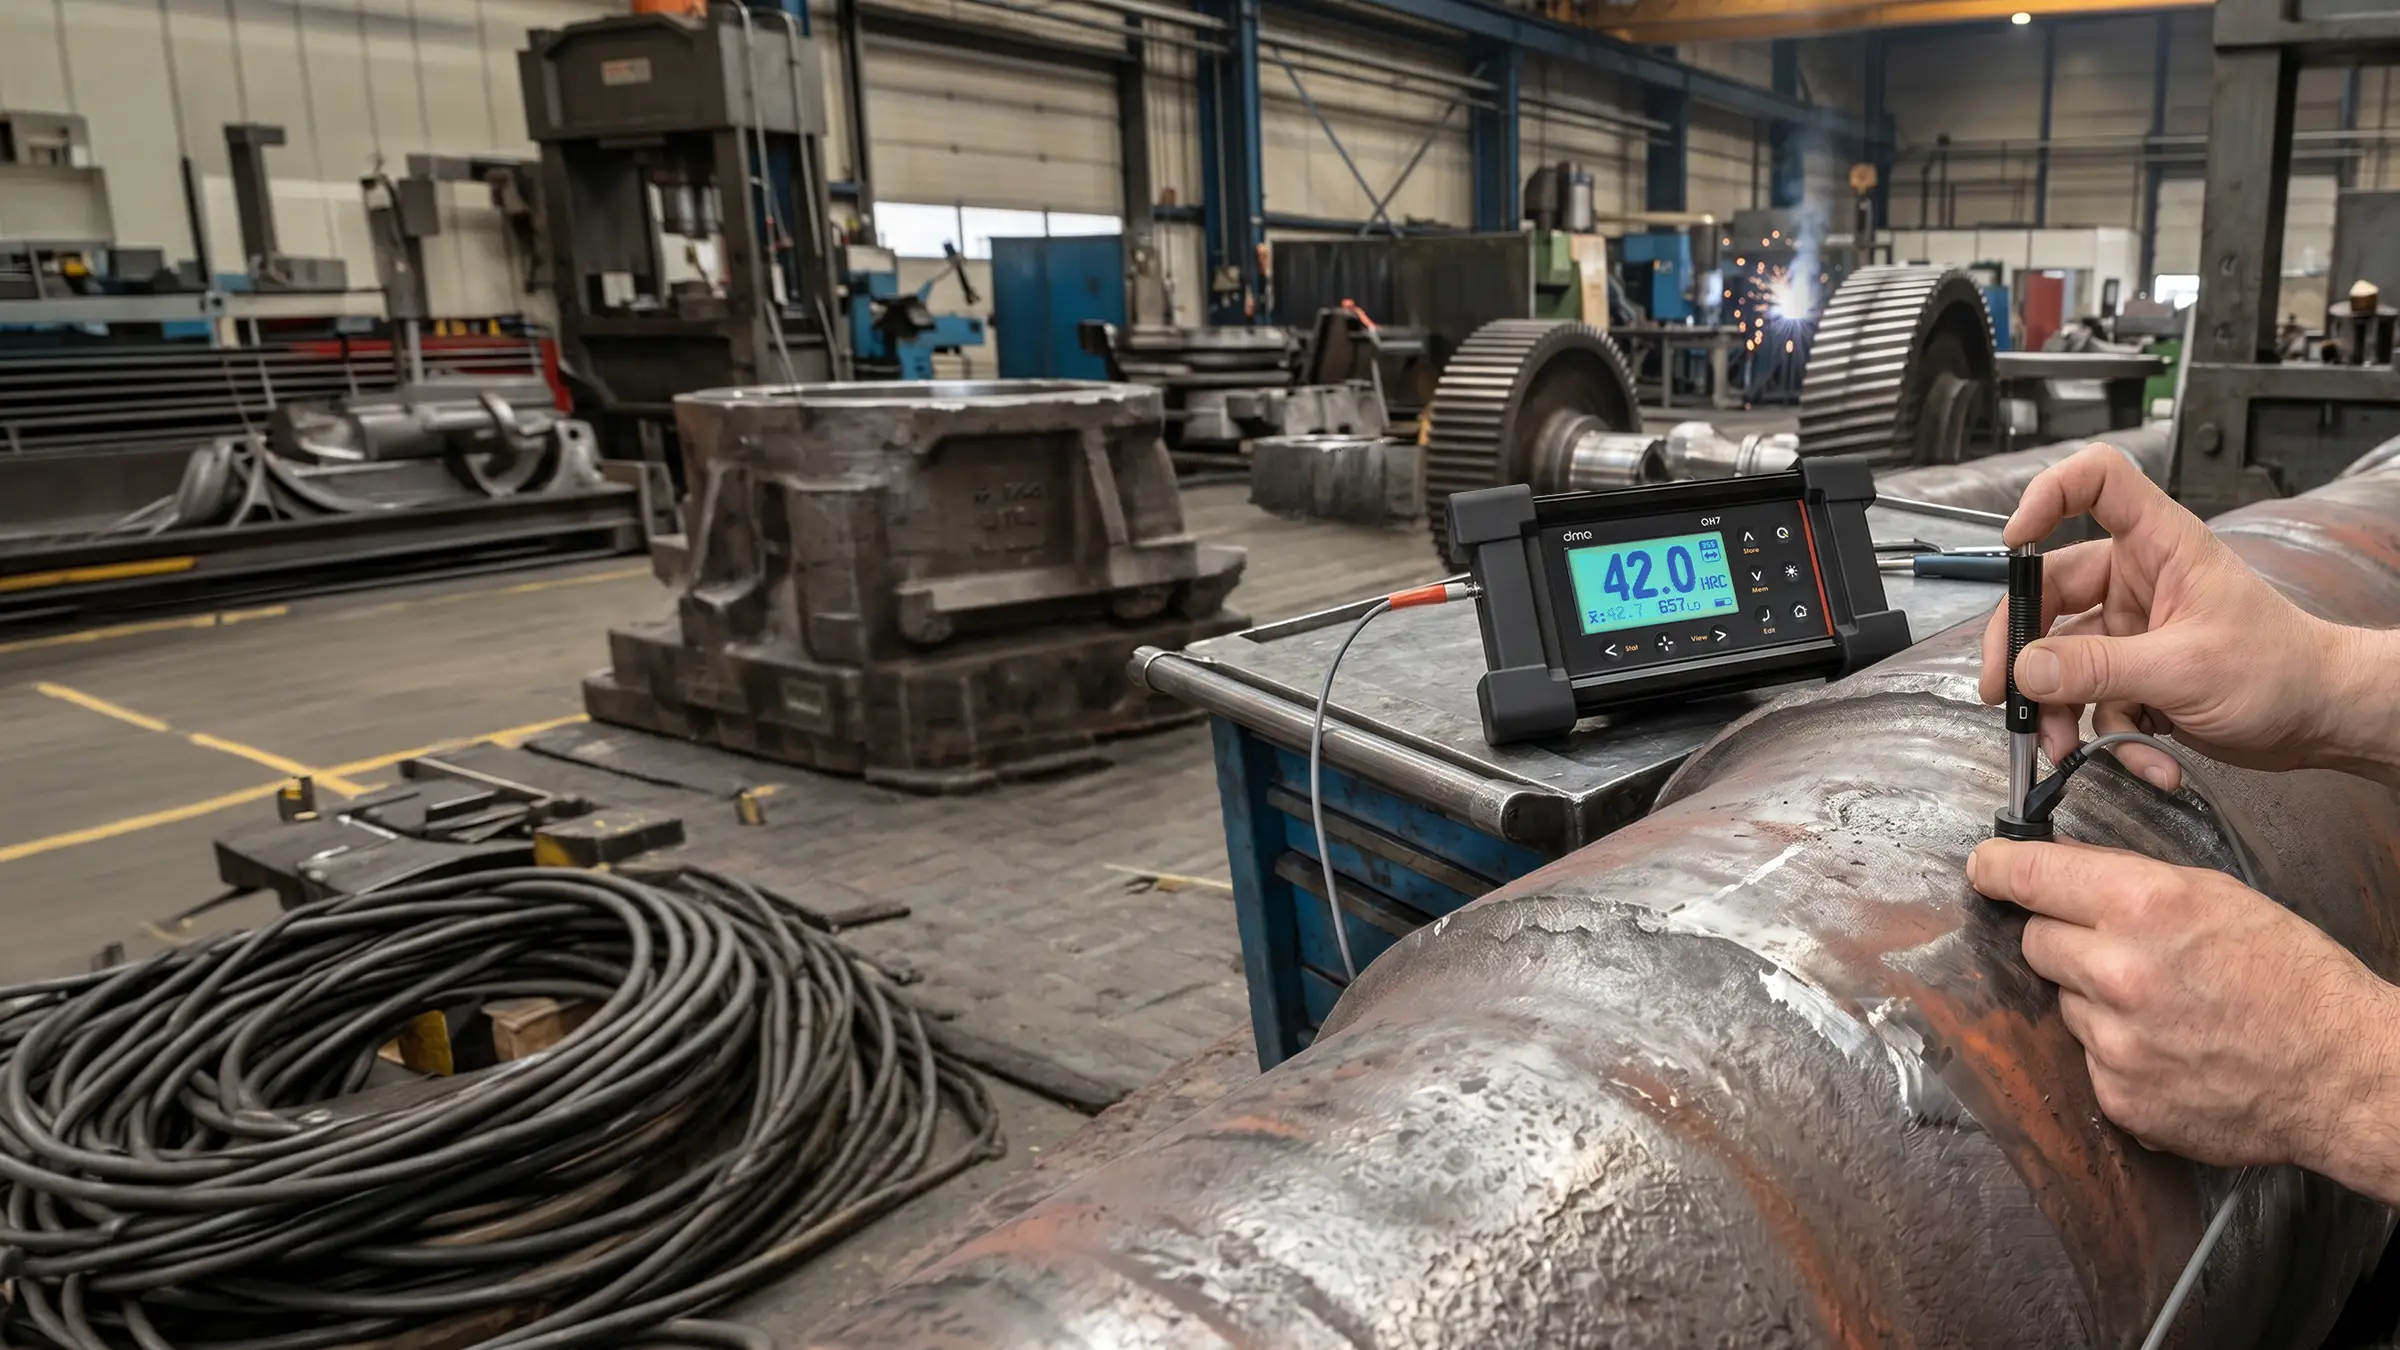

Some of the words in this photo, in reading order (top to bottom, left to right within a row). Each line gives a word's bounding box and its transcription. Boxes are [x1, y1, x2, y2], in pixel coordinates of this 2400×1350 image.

[1701, 516, 1721, 527] QH7
[1743, 547, 1760, 555] Store
[1604, 545, 1697, 601] 42.0
[1700, 574, 1728, 591] HRC
[1751, 586, 1769, 594] Mem
[1607, 603, 1643, 621] 42.7
[1658, 597, 1686, 615] 657
[1763, 627, 1776, 635] Edit
[1690, 634, 1708, 643] View
[1625, 644, 1639, 652] Stat
